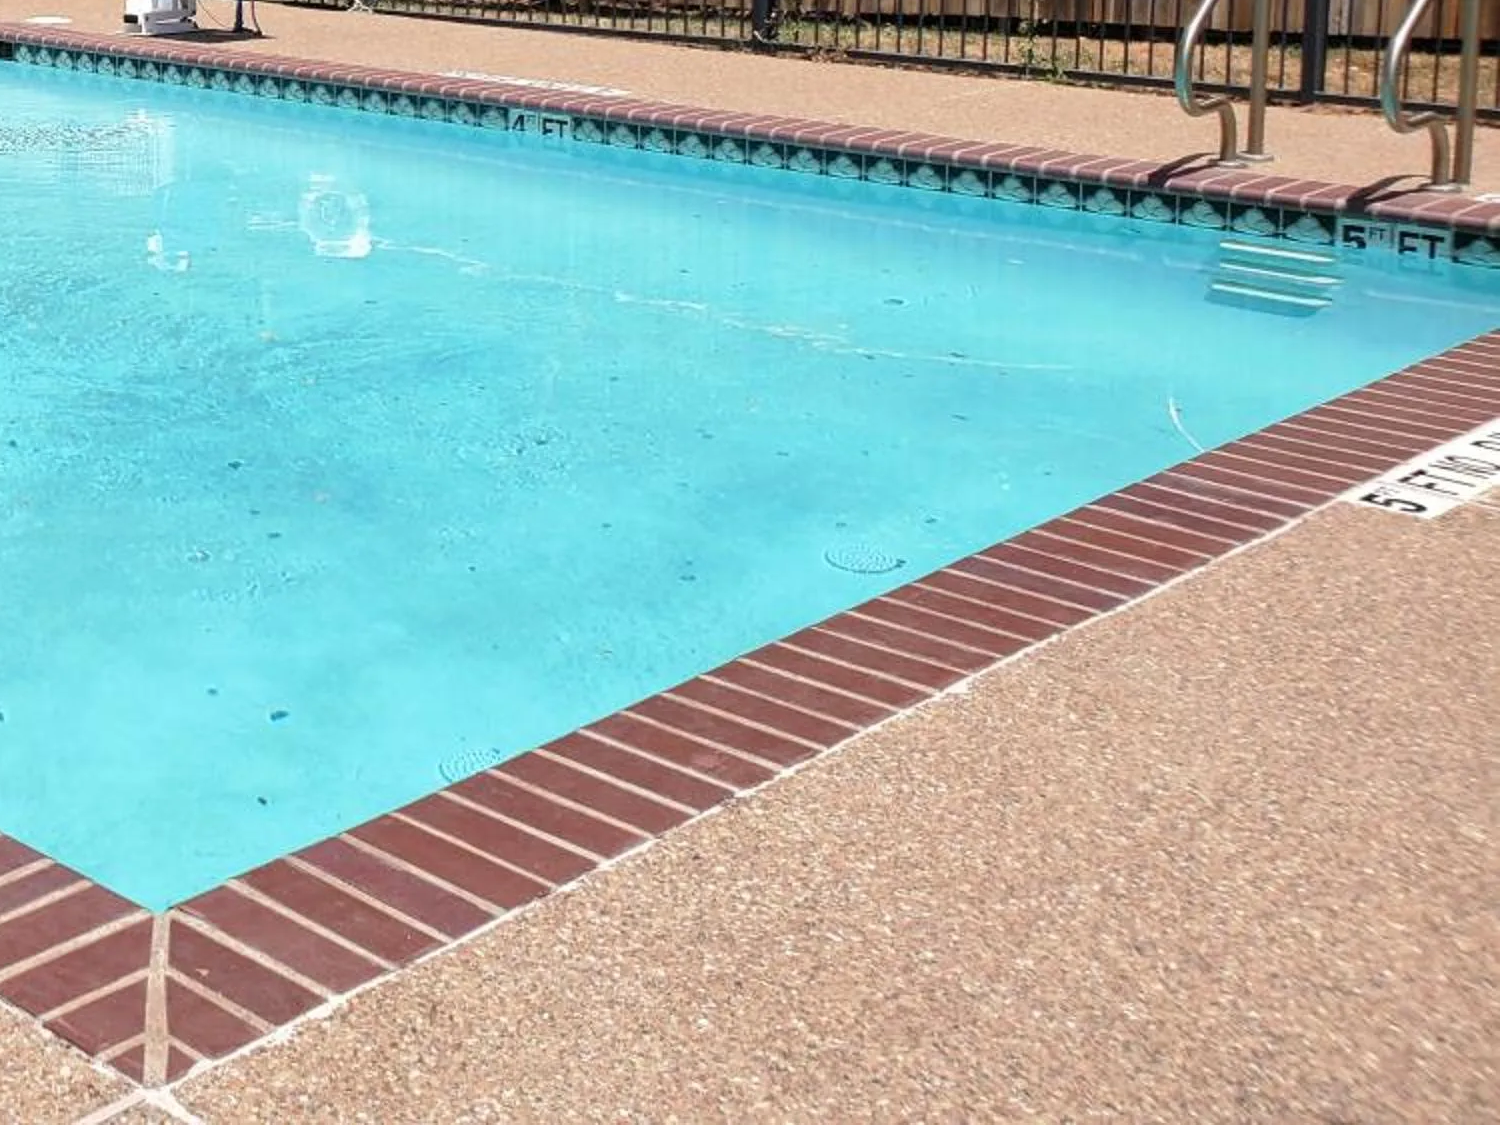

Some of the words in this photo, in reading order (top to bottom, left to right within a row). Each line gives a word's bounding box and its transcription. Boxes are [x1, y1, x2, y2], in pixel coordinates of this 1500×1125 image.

[511, 114, 525, 132] 4
[541, 118, 569, 139] FT
[1342, 224, 1367, 250] 5
[1398, 230, 1445, 260] FT
[1358, 492, 1428, 513] 5
[1396, 469, 1477, 495] FT
